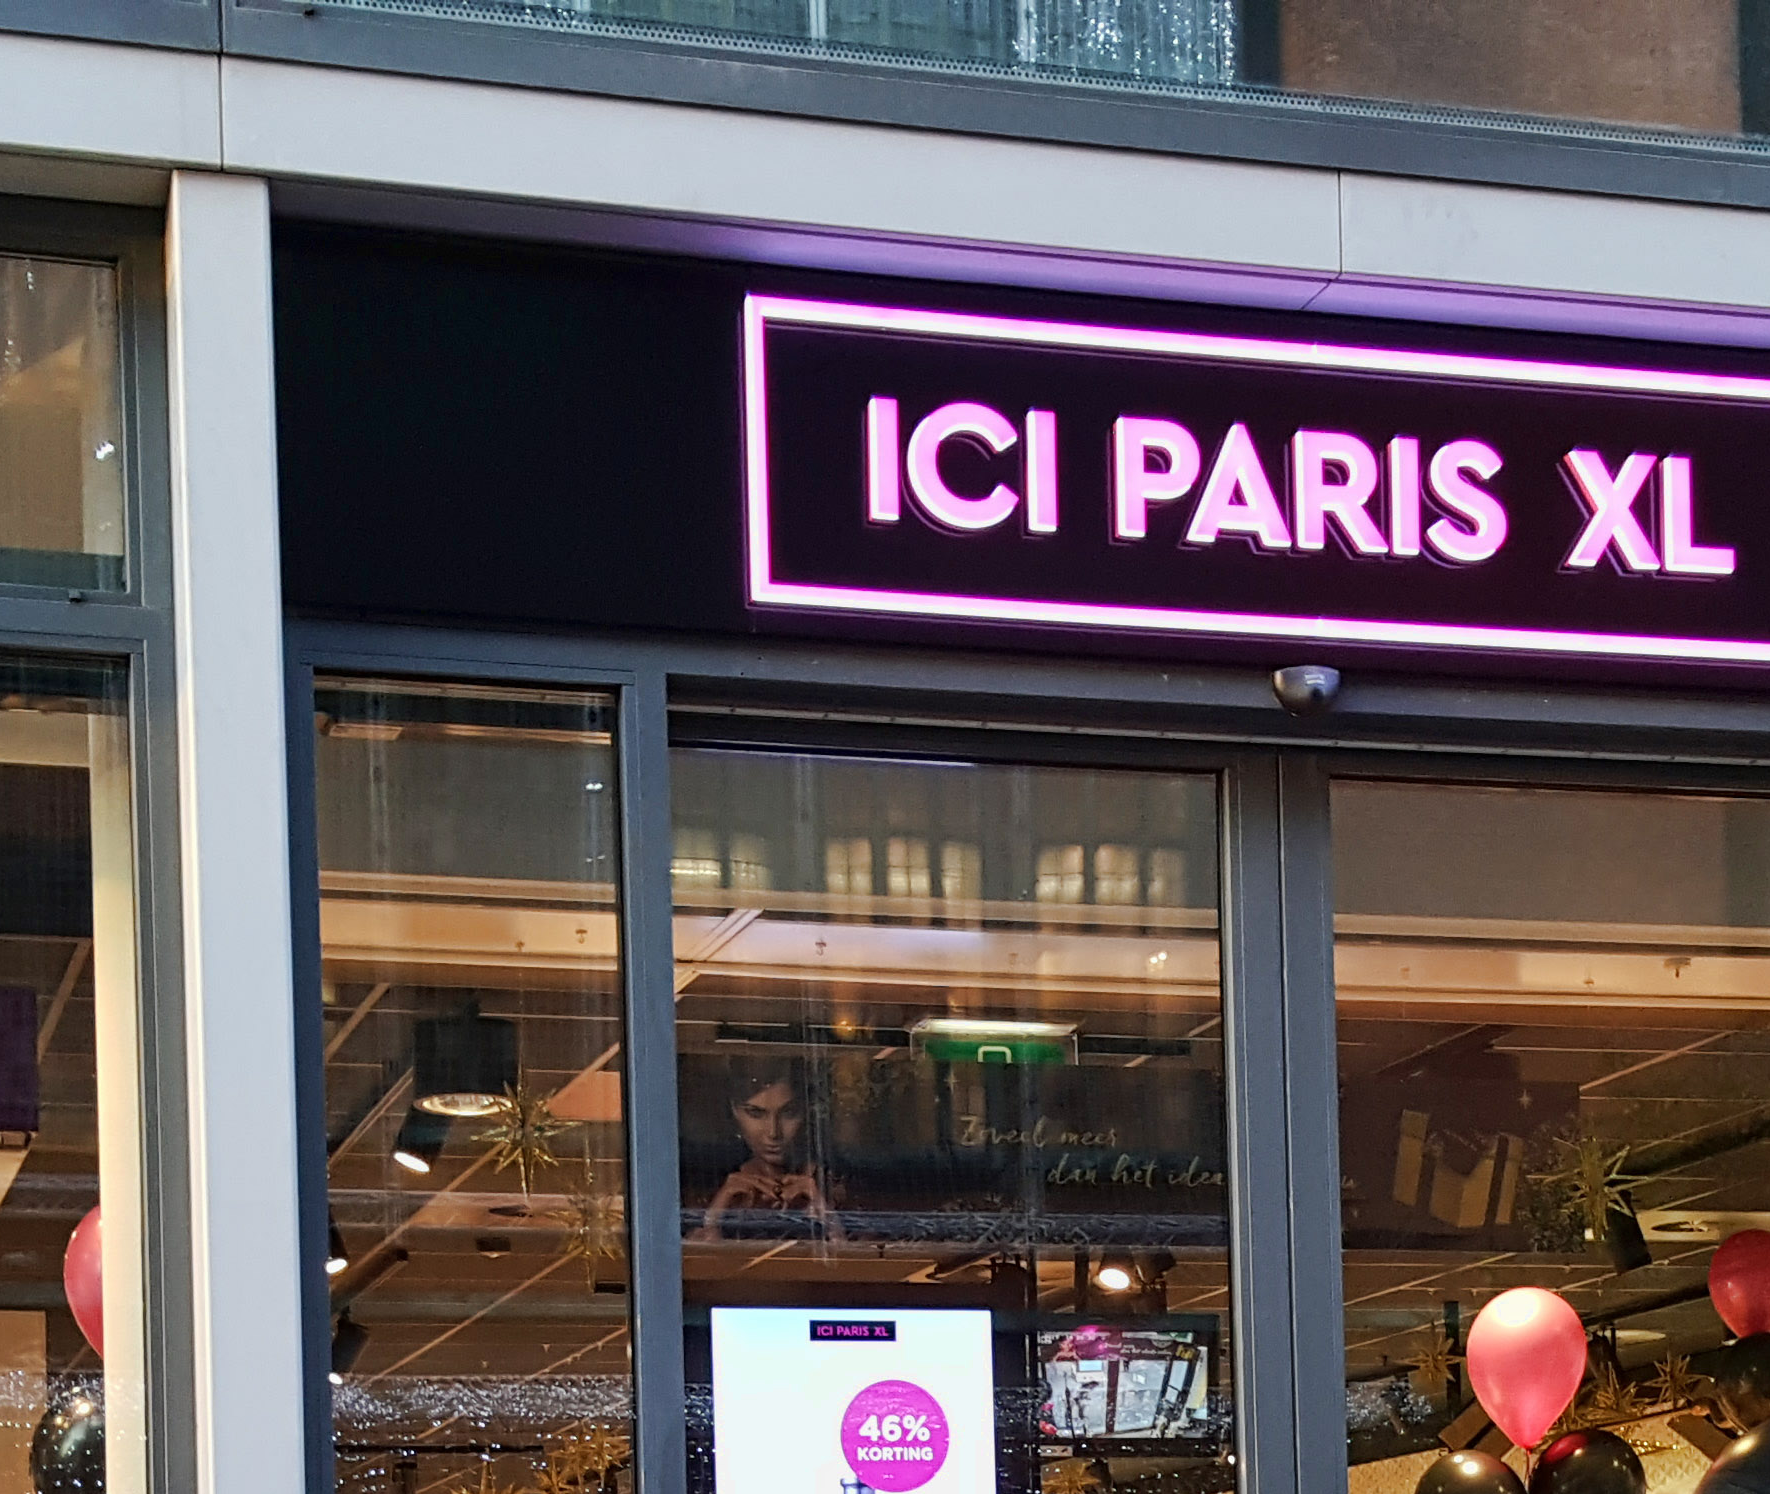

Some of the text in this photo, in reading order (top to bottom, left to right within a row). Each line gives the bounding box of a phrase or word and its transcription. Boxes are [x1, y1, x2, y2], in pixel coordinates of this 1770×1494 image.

[866, 396, 1737, 577] ICI PARIS XL
[1110, 1152, 1158, 1189] het
[1167, 1155, 1225, 1188] idea
[816, 1325, 889, 1337] ICI PARIS XL
[858, 1414, 931, 1442] 46%
[856, 1446, 934, 1462] KORTING
